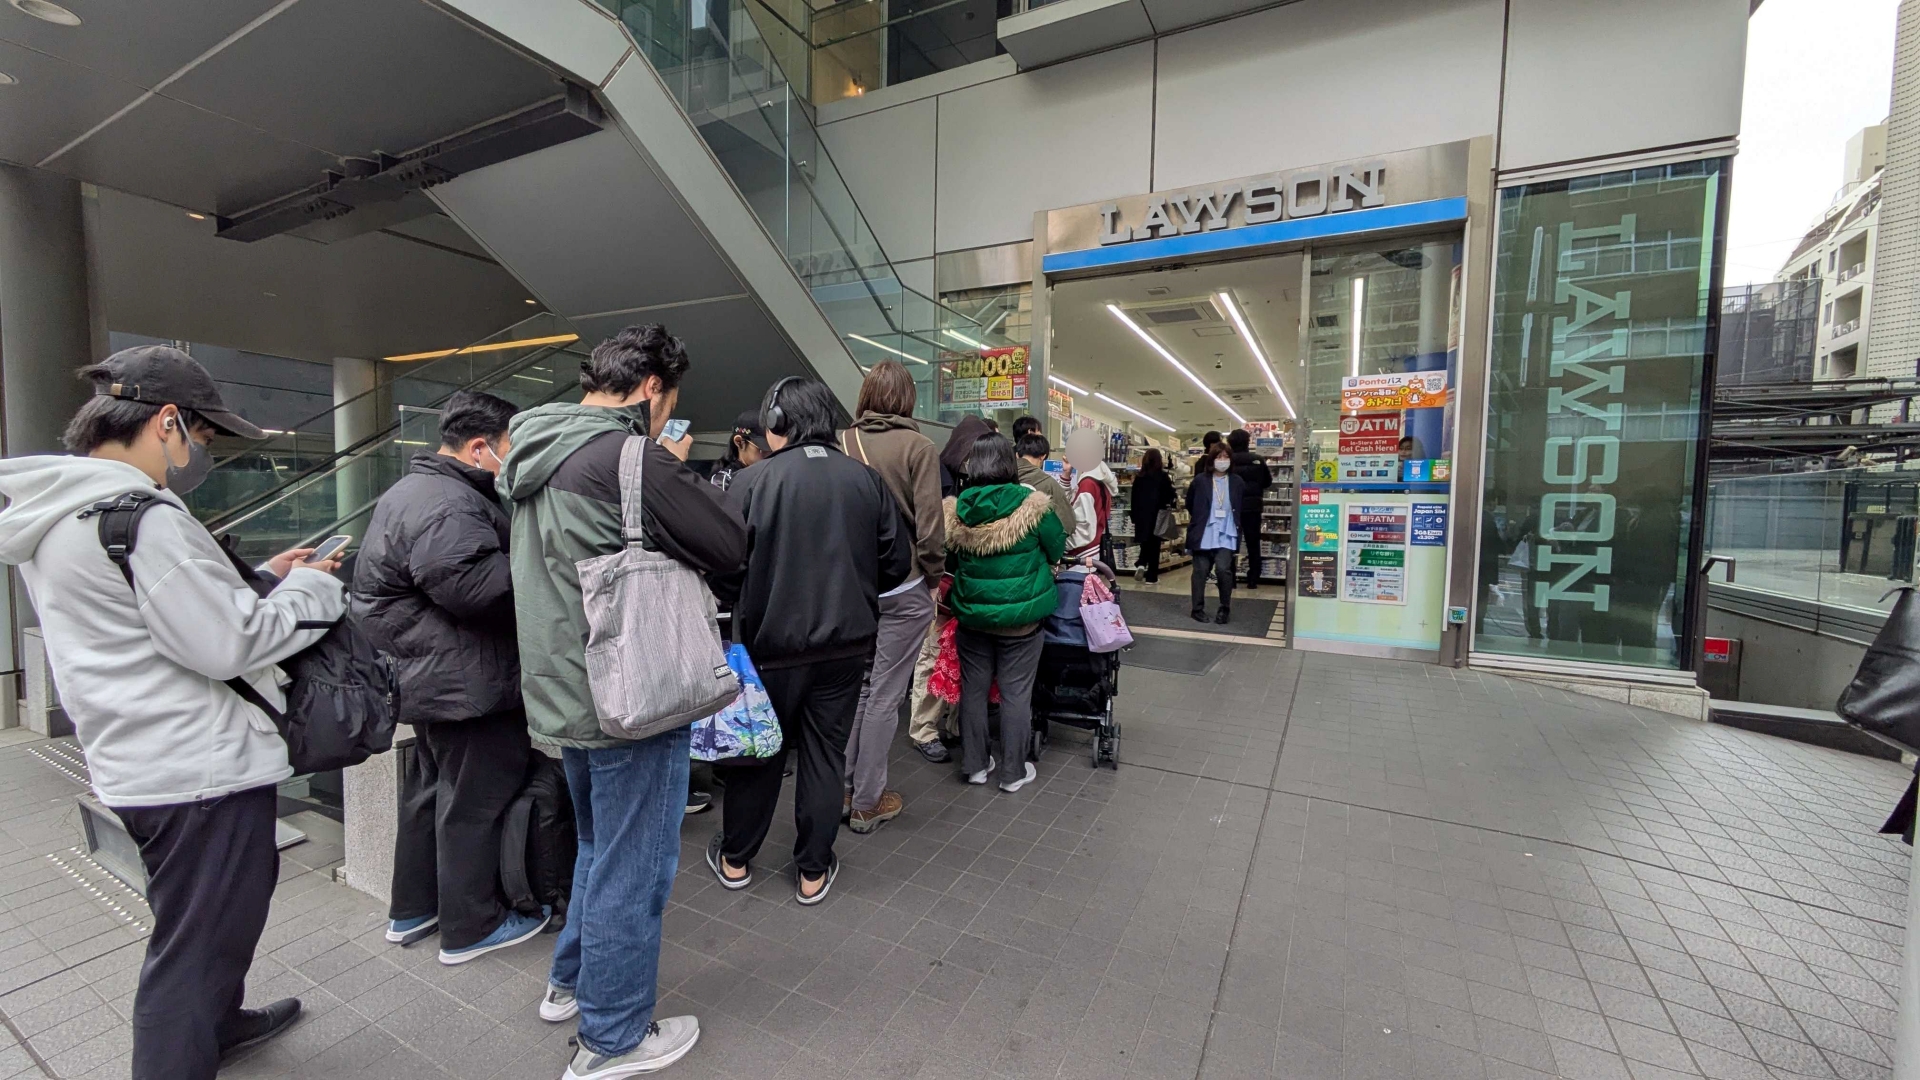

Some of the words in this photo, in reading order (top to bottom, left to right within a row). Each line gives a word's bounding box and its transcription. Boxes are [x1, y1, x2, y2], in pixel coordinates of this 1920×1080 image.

[1099, 161, 1386, 246] LAWSON
[1534, 213, 1637, 612] LAWSON
[1360, 418, 1398, 431] ATM
[1375, 444, 1397, 452] Here!
[1359, 515, 1395, 523] 銀行ATM
